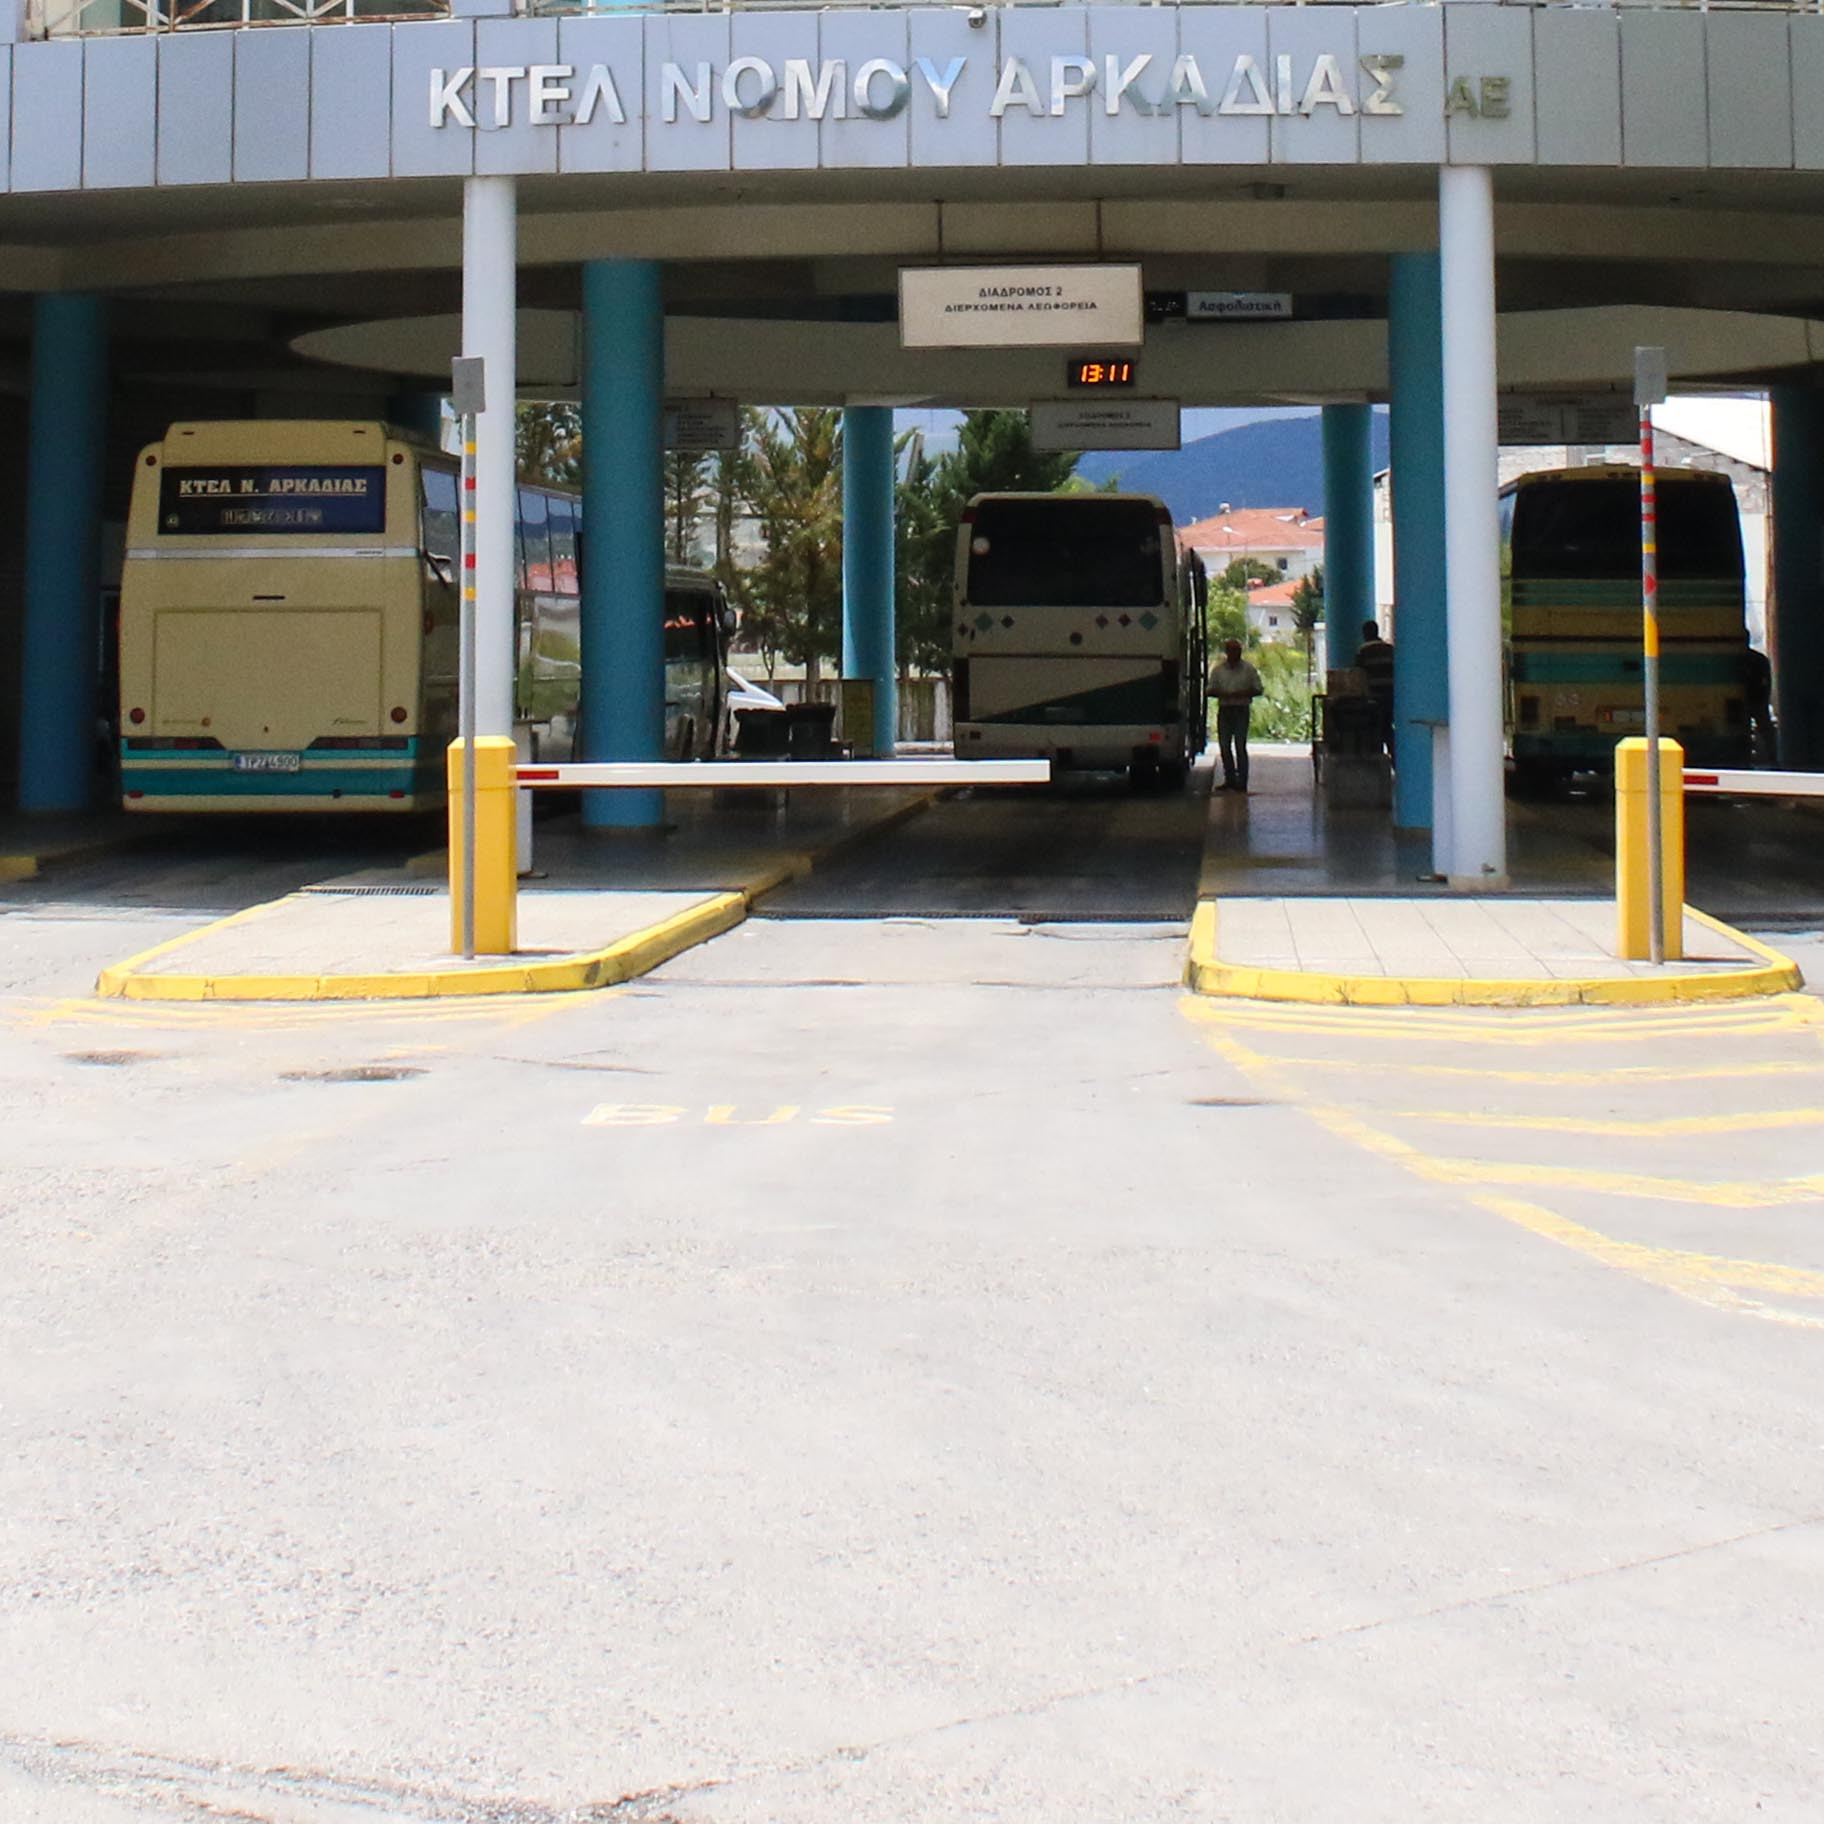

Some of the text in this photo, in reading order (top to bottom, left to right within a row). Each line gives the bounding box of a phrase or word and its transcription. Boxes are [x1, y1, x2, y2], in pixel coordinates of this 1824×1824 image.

[429, 52, 1511, 128] ΚΤΕΛ ΝΟΜΟΥ ΑΡΚΑΔΙΑΣ ΑΕ
[978, 287, 1063, 298] ΔΙΑΔΡΟΜΟΣ 2
[944, 302, 1098, 314] ΔΙΕΡΧΟΜΕΝΑ ΛΕΩΦΟΡΕΙΑ
[1080, 364, 1129, 383] 13:11
[179, 480, 231, 494] ΚΤΕΛ
[269, 478, 368, 493] ΑΡΚΑΔΙΑΣ
[581, 1103, 896, 1126] BUS
